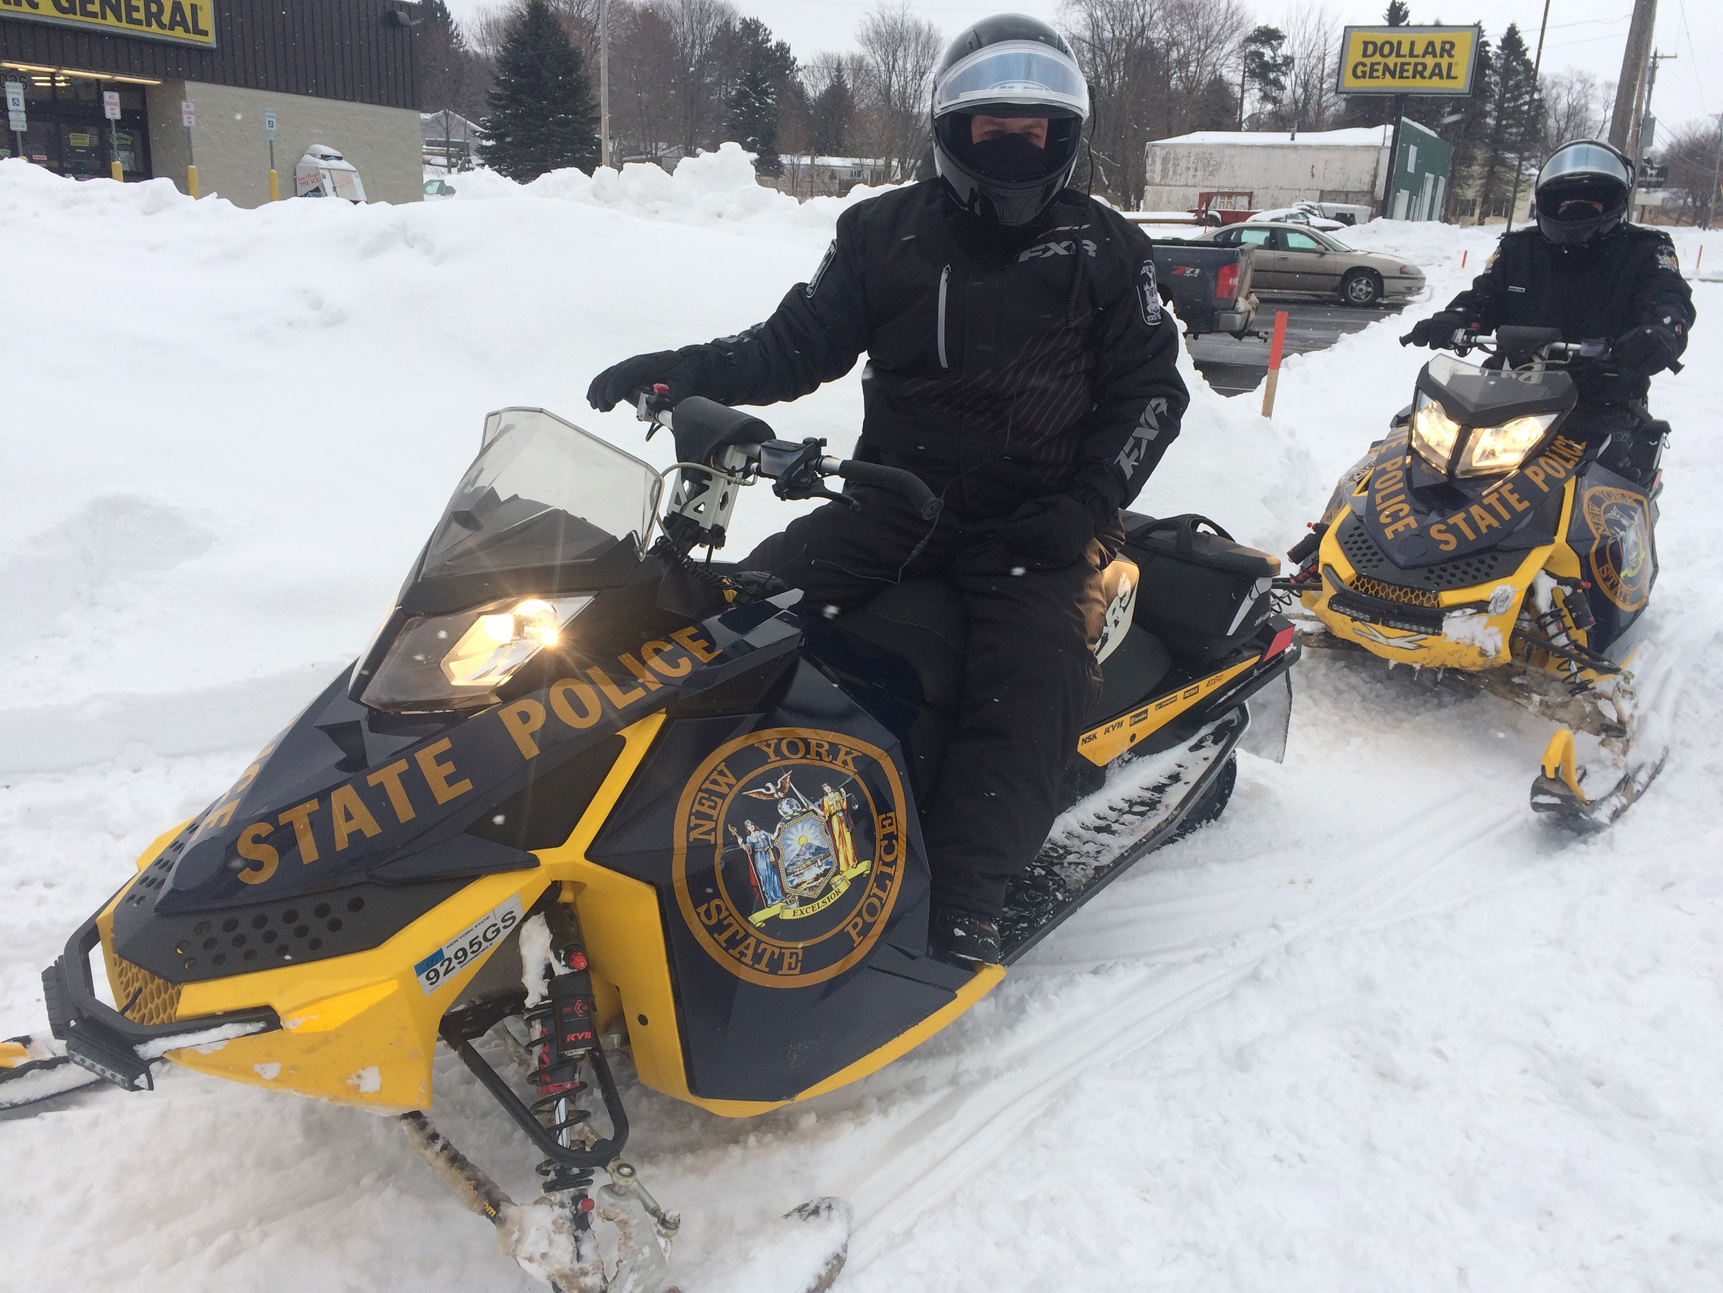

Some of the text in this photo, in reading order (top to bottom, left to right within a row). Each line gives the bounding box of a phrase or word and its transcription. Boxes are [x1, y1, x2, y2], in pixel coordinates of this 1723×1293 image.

[1361, 40, 1456, 59] DOLLAR
[1351, 61, 1458, 80] GENERAL
[1017, 239, 1098, 263] FXR
[1113, 397, 1169, 480] FXR
[1374, 455, 1418, 540] POLICE
[1429, 434, 1587, 551] STATE POLICE
[1599, 563, 1632, 606] STATE
[1081, 719, 1125, 746] NSK KYB
[236, 737, 473, 886] STATE
[497, 626, 723, 760] POLICE
[689, 736, 863, 845] NEW YORK
[697, 811, 899, 975] STATE POLICE
[792, 887, 843, 918] EXCELSIOR
[425, 910, 517, 986] 9295GS
[446, 915, 490, 949] NEW YORK STATE
[459, 942, 494, 969] SNOWMOBILE
[566, 1031, 592, 1042] KYB
